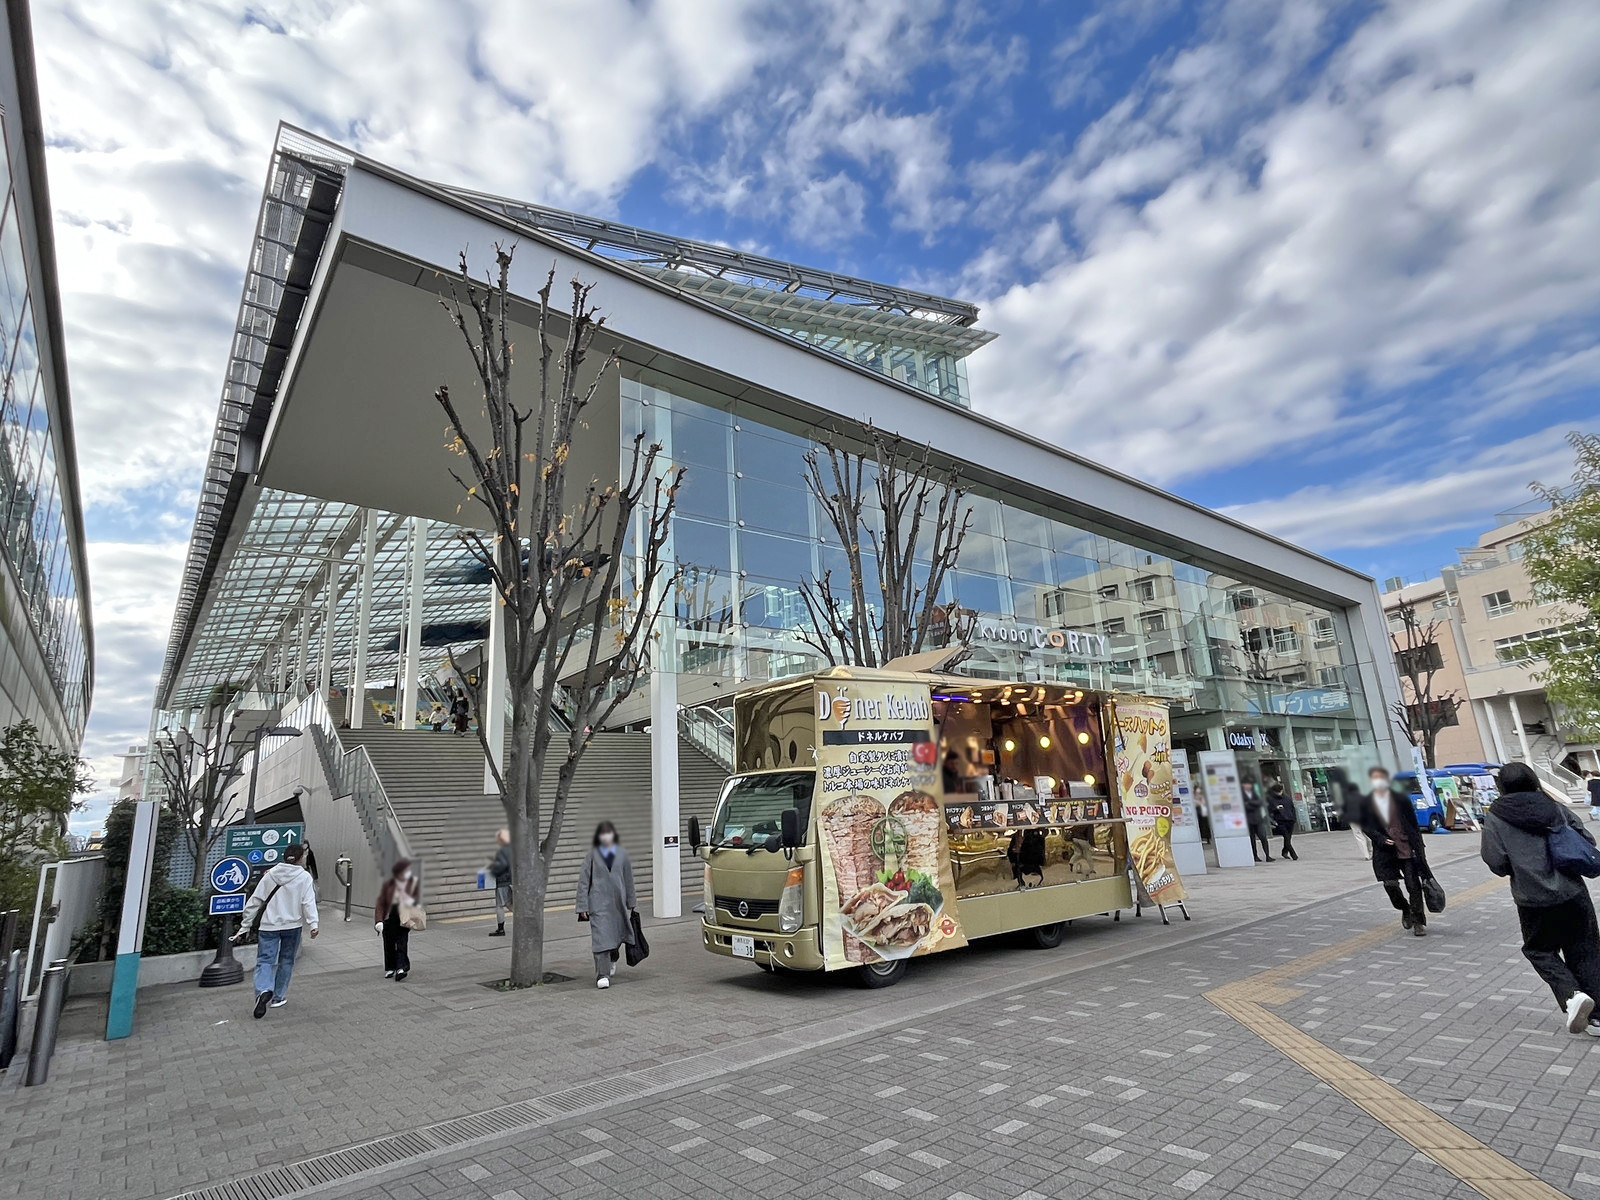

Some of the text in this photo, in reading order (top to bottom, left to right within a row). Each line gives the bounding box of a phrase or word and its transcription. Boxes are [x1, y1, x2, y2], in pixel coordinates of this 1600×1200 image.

[980, 624, 1105, 656] KYODO CORTY
[884, 693, 929, 720] Kebab
[858, 731, 905, 742] ドネルケバブ
